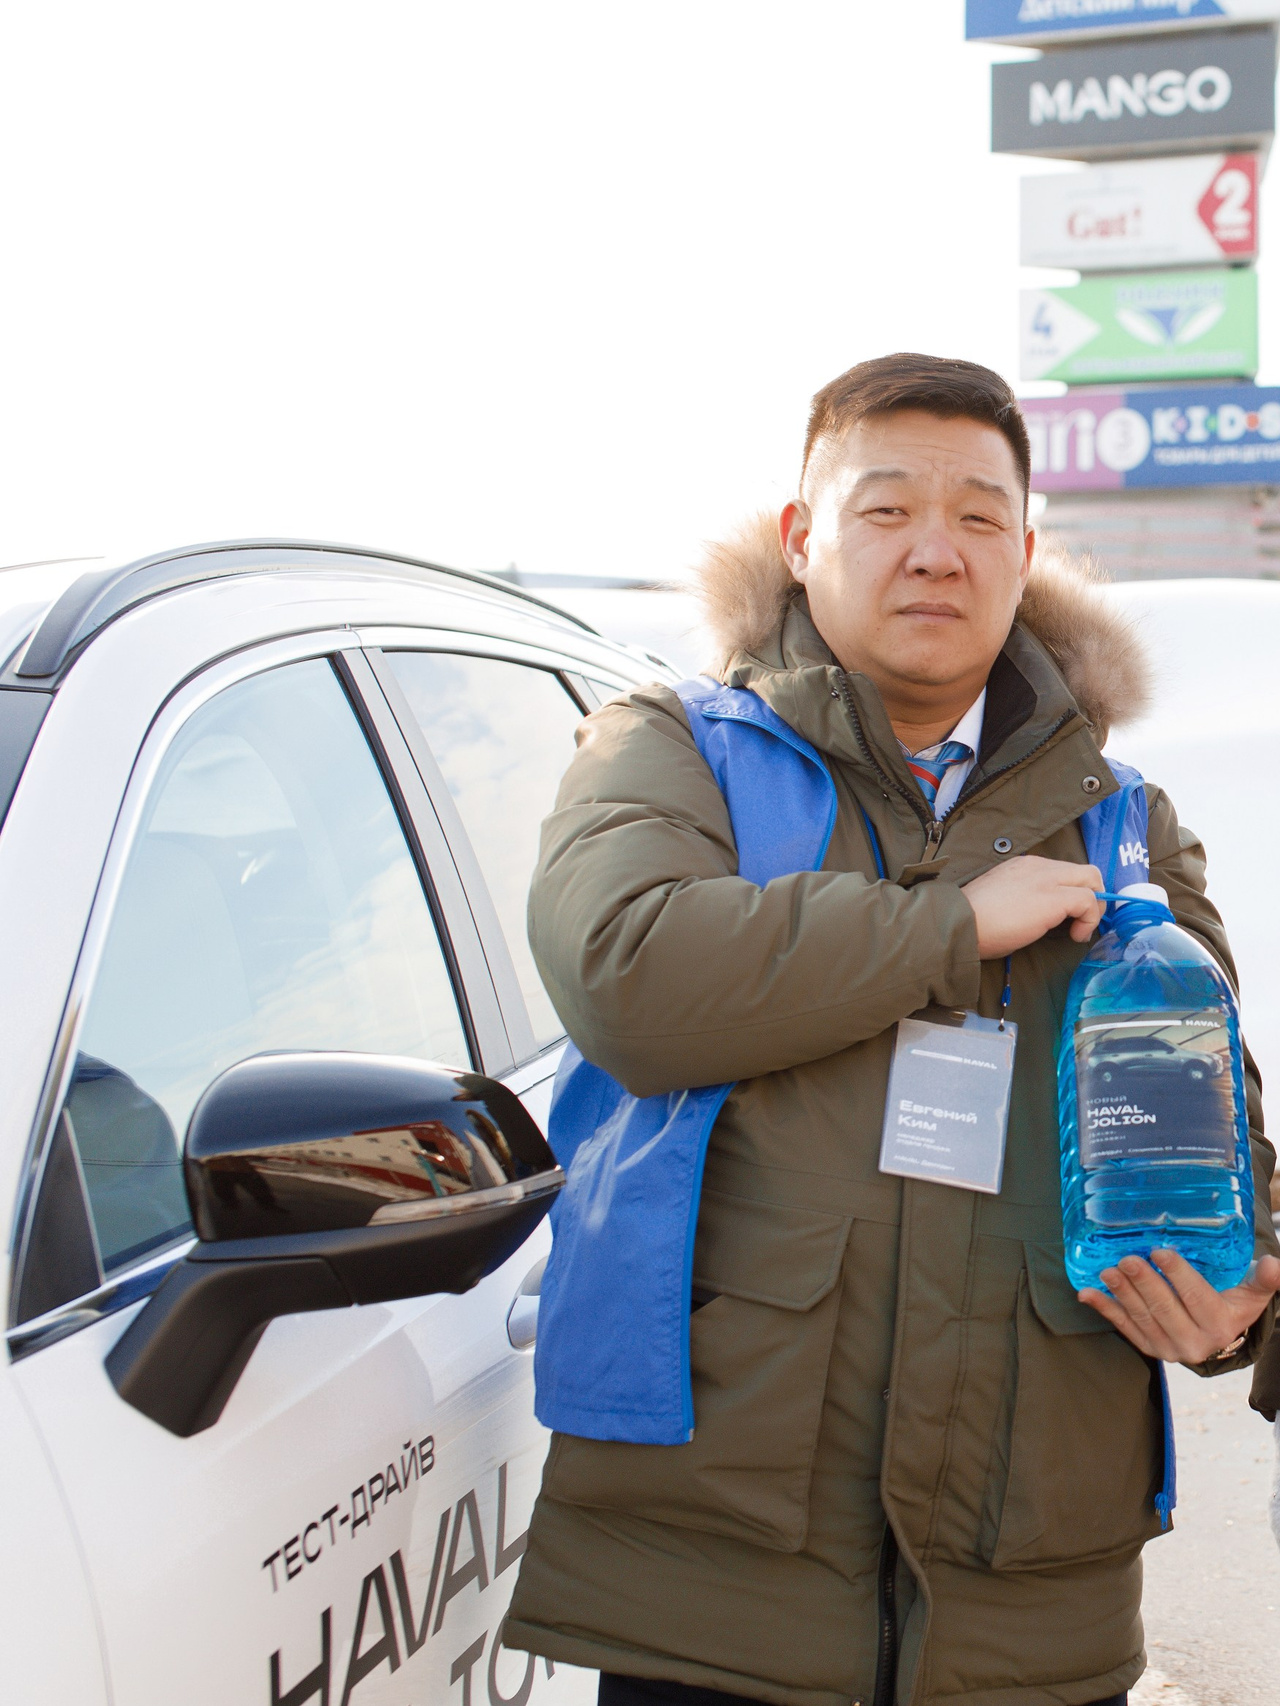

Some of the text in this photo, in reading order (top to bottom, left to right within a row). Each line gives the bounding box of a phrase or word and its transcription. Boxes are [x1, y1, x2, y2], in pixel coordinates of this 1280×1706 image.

[1028, 65, 1233, 126] MANGO
[1213, 168, 1252, 227] 2
[1185, 1019, 1221, 1028] HAVAL
[897, 1114, 938, 1132] Ким
[899, 1099, 978, 1125] Евгений
[1087, 1104, 1145, 1118] HAVAL
[1088, 1114, 1157, 1129] JOLION
[262, 1434, 436, 1594] ТЕСТ-ДРАЙВ
[269, 1461, 529, 1706] HAVAL
